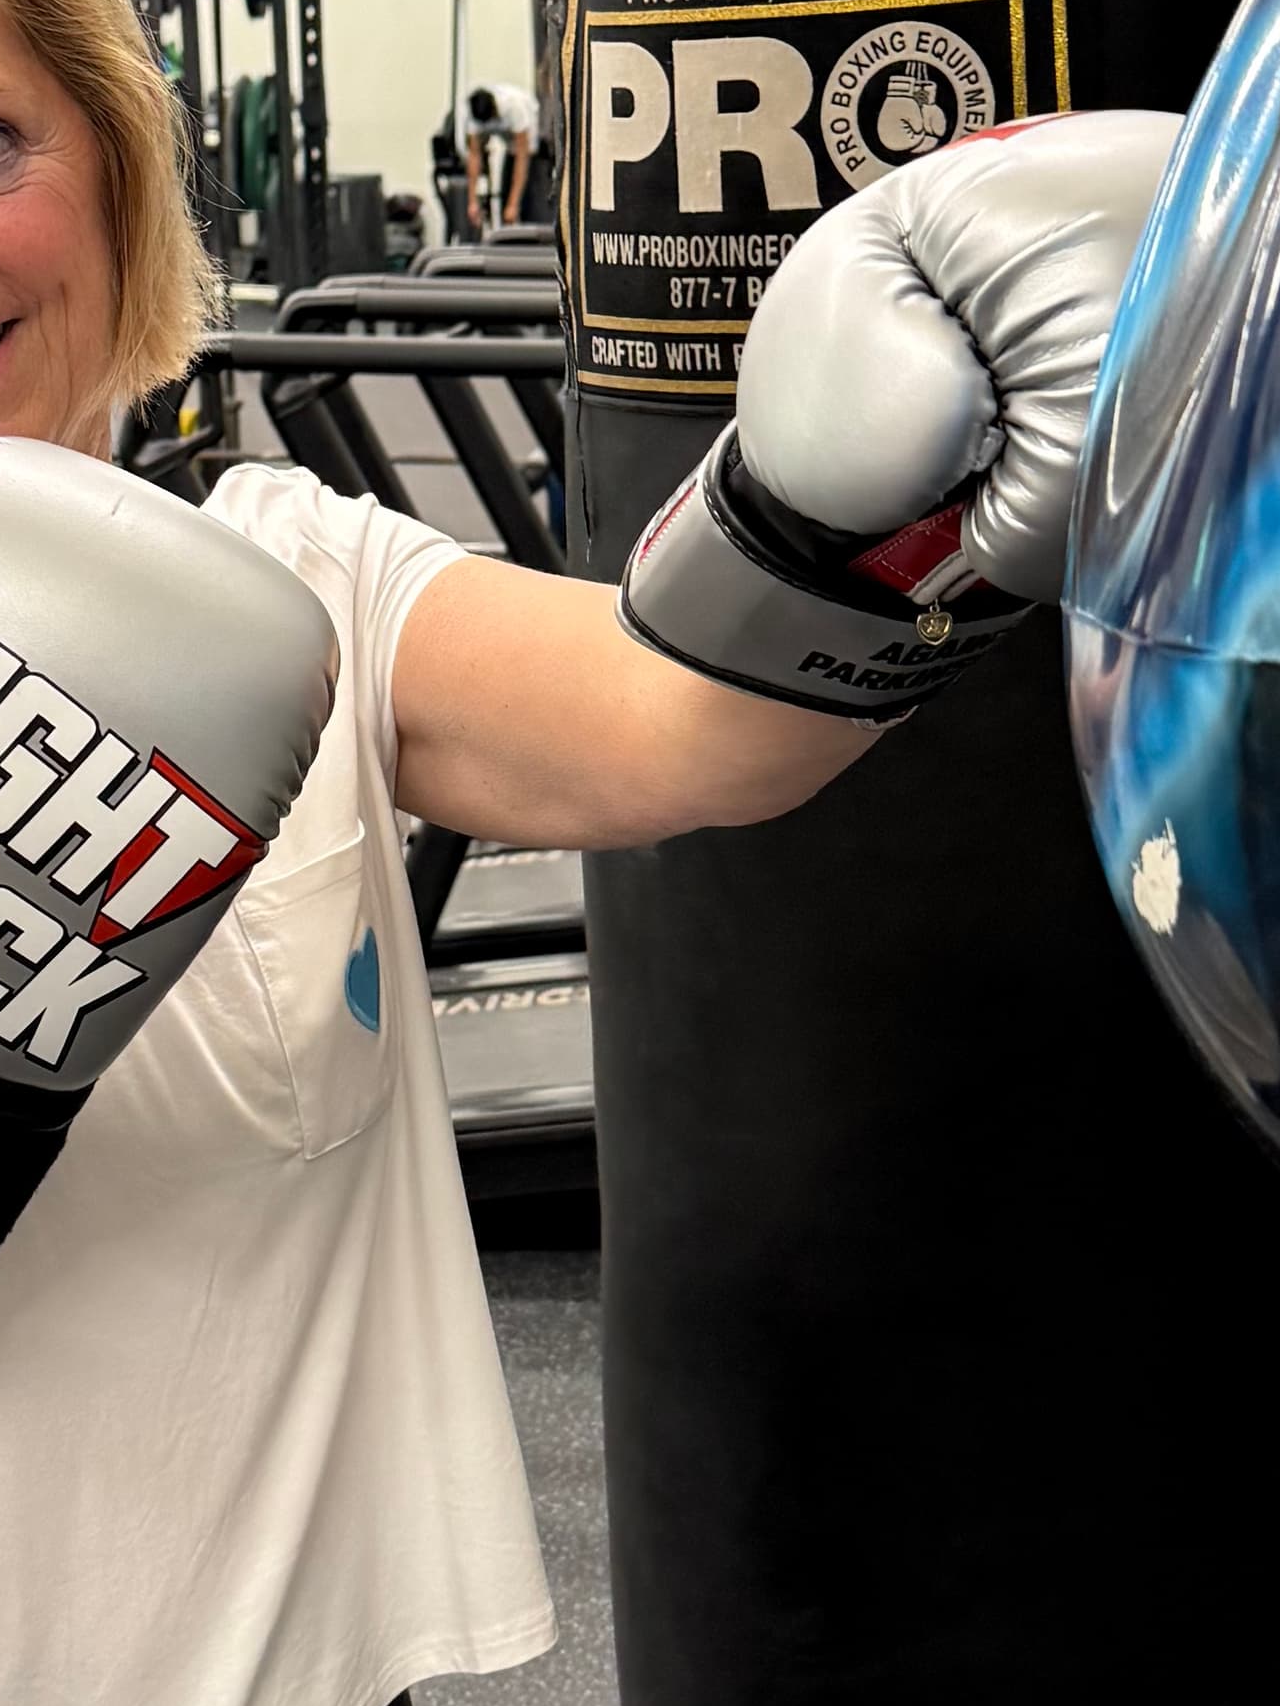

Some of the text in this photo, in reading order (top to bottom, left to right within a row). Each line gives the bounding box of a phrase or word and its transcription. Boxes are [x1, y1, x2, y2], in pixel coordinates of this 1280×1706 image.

[830, 30, 988, 173] PRO BOXING EQUIPME
[670, 276, 737, 309] 877-7
[591, 335, 658, 370] CRAFTED
[665, 341, 722, 372] WITH
